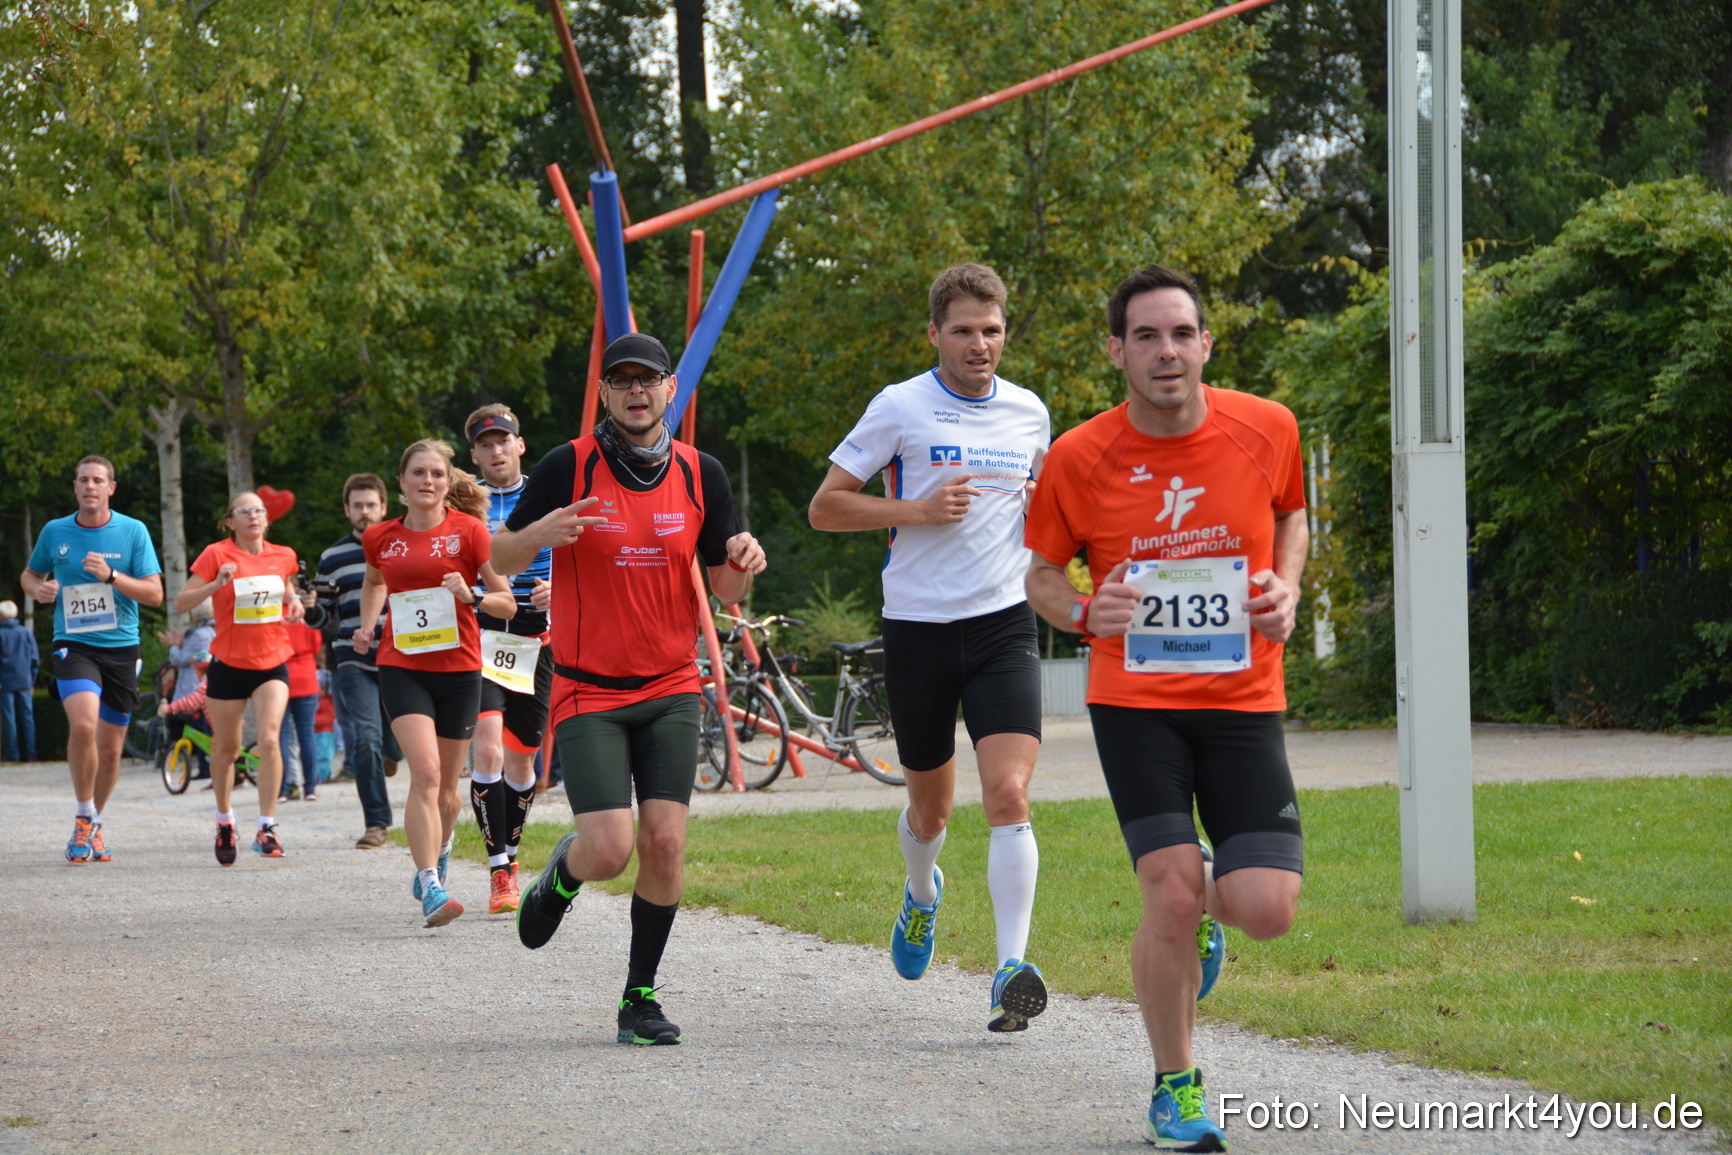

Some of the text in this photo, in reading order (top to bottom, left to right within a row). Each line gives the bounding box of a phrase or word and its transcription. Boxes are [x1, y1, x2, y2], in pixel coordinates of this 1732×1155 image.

[933, 410, 961, 418] Wolfgang
[936, 417, 960, 425] Hofbeck
[967, 447, 1028, 461] Raiffeisenbank
[985, 459, 1020, 469] Rothsee
[1020, 463, 1029, 471] eG
[1129, 473, 1153, 483] erima
[1130, 524, 1228, 555] funrunners
[621, 546, 663, 554] Gruber
[1160, 535, 1242, 558] neumarkt
[1169, 569, 1212, 580] BOCK
[252, 591, 269, 605] 77
[70, 596, 106, 615] 2154
[1142, 594, 1230, 628] 2133
[415, 609, 428, 628] 3
[409, 632, 441, 644] Stephanie
[1162, 640, 1211, 652] Michael
[493, 649, 516, 670] 89
